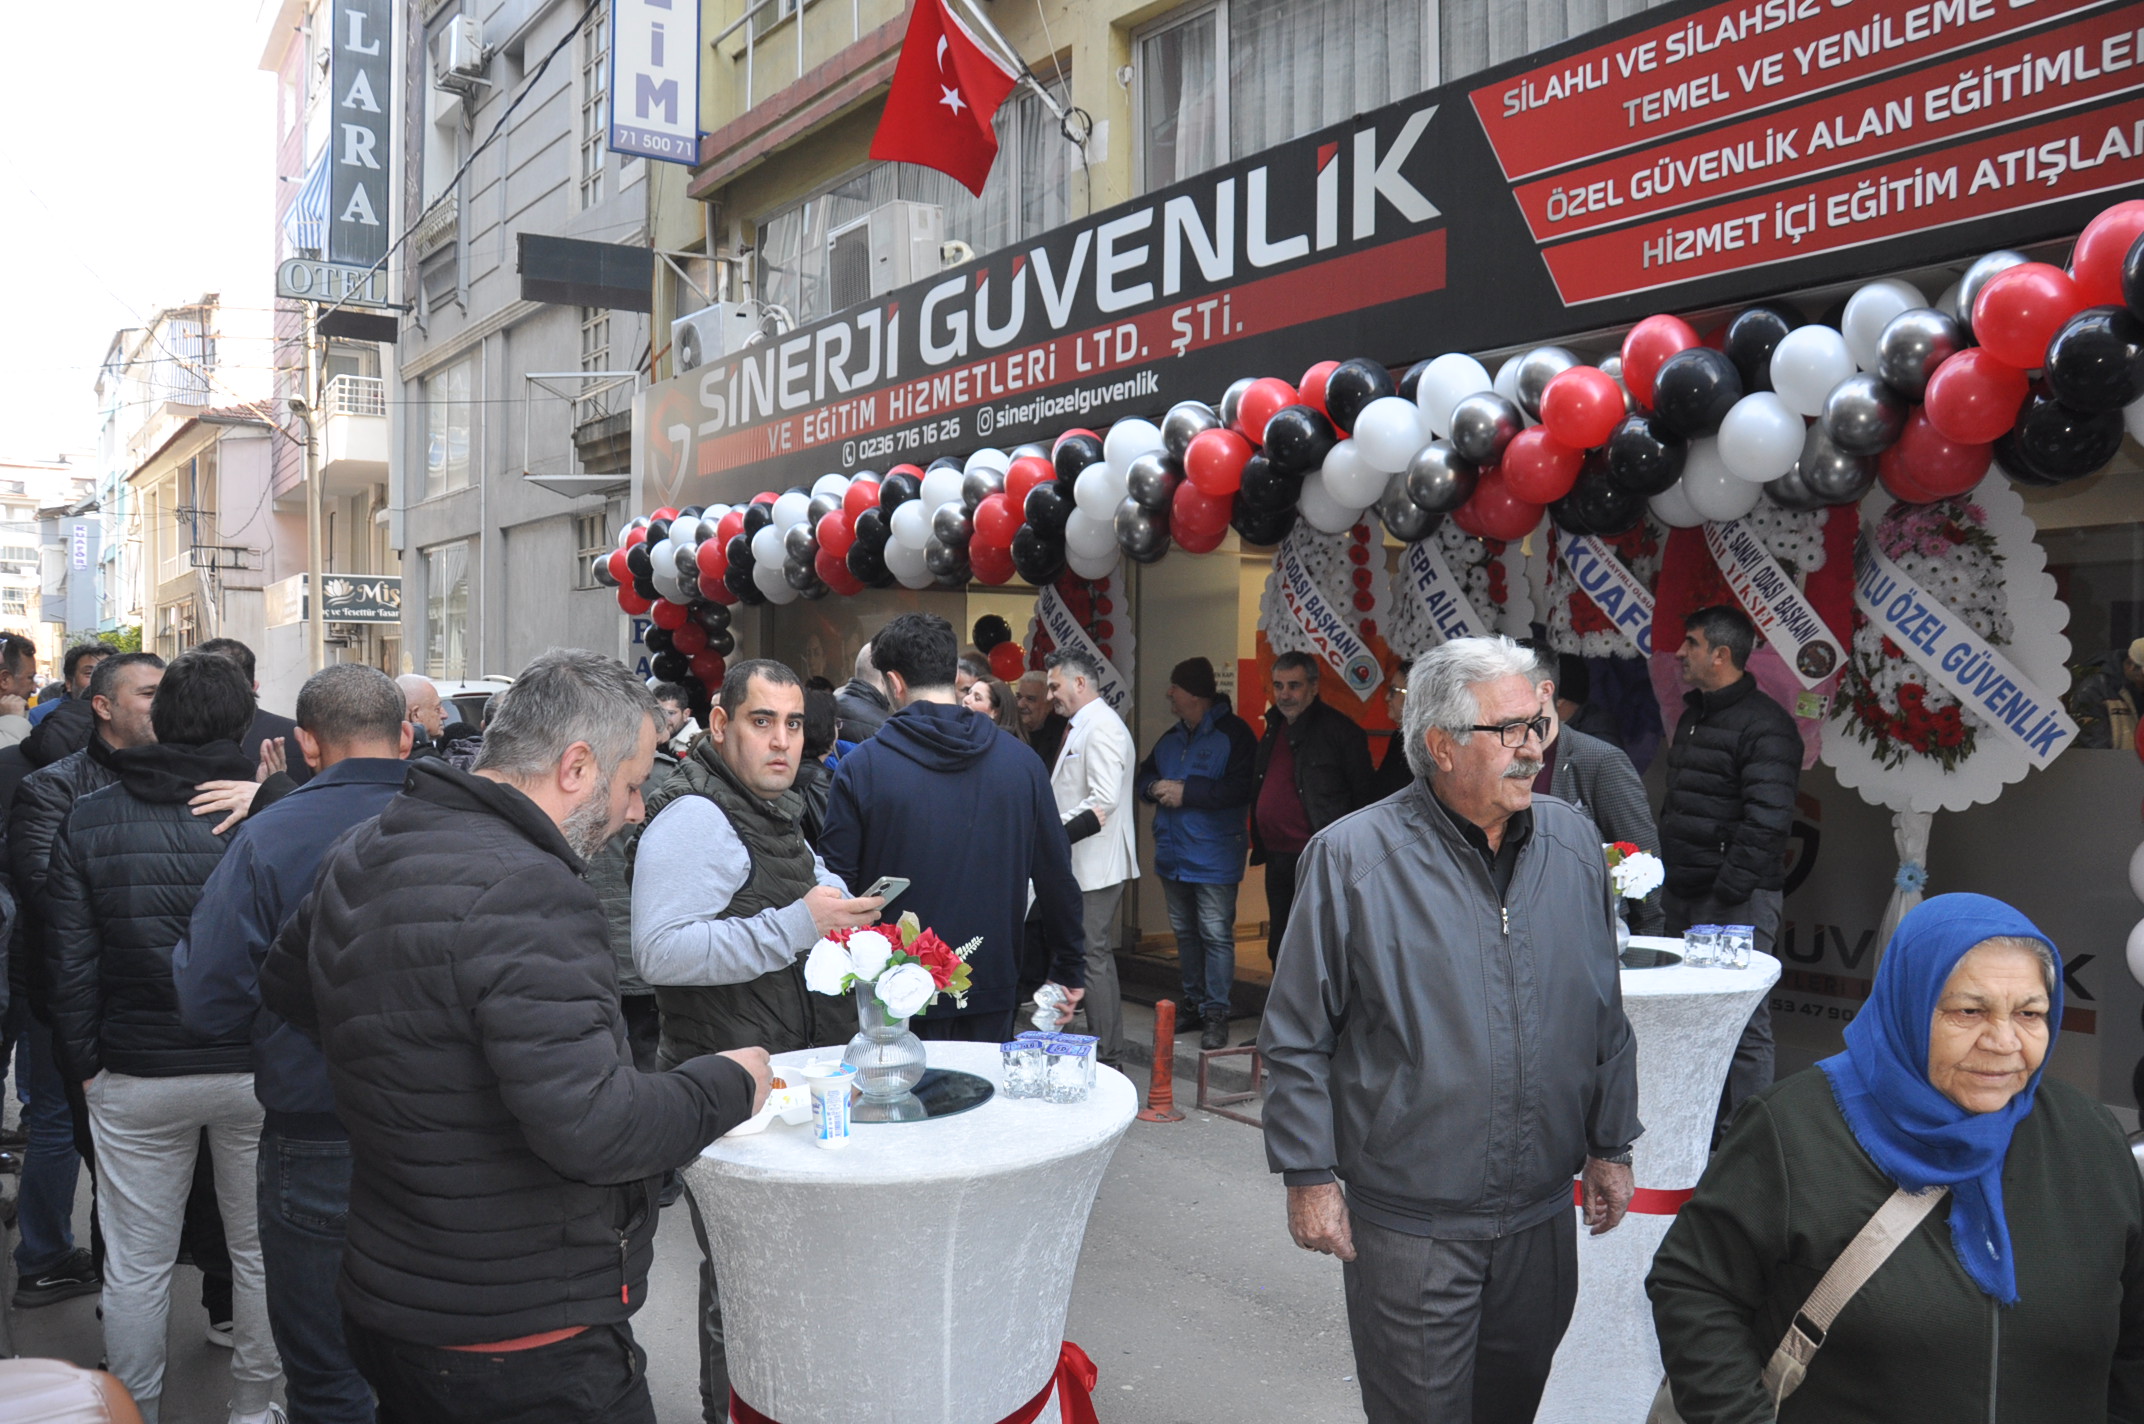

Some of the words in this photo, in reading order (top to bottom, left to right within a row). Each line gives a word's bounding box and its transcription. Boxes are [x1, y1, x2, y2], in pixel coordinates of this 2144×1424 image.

[1503, 56, 1609, 118] SİLAHLI
[1615, 40, 1658, 79] VE
[1622, 73, 1730, 128] TEMEL
[1736, 52, 1784, 93] VE
[1793, 0, 1996, 76] YENİLEME
[340, 9, 382, 226] LARA
[619, 129, 636, 145] 71
[642, 136, 671, 152] 500
[676, 140, 692, 156] 71
[1547, 179, 1624, 222] ÖZEL
[1630, 128, 1799, 200] GÜVENLİK
[1807, 96, 1913, 156] ALAN
[1642, 212, 1767, 269] HİZMET
[1774, 194, 1816, 244] İÇİ
[1827, 166, 1958, 228] EĞİTİM
[284, 262, 386, 304] OTEL
[697, 302, 899, 436] SİNERJİ
[919, 103, 1442, 366] GÜVENLİK
[767, 421, 792, 452] VE
[1076, 323, 1148, 373] LTD.
[1171, 294, 1243, 358] ŞTİ.
[996, 370, 1159, 428] sinerjiozelguvenlik
[859, 436, 894, 459] 0236
[897, 427, 919, 451] 716
[922, 422, 938, 445] 16
[940, 417, 960, 439] 26
[341, 607, 376, 617] Tesettür
[1285, 556, 1312, 600] ODASI
[1304, 595, 1361, 660] BAŞKANI
[1425, 590, 1474, 641] AİLE
[1728, 531, 1769, 573] SANAYİ
[1751, 565, 1787, 603] ODASI
[1773, 594, 1820, 645] BAŞKANI
[1885, 587, 1948, 657] ÖZEL
[1941, 642, 2068, 758] GÜVENLİK
[1799, 1003, 1824, 1016] 47
